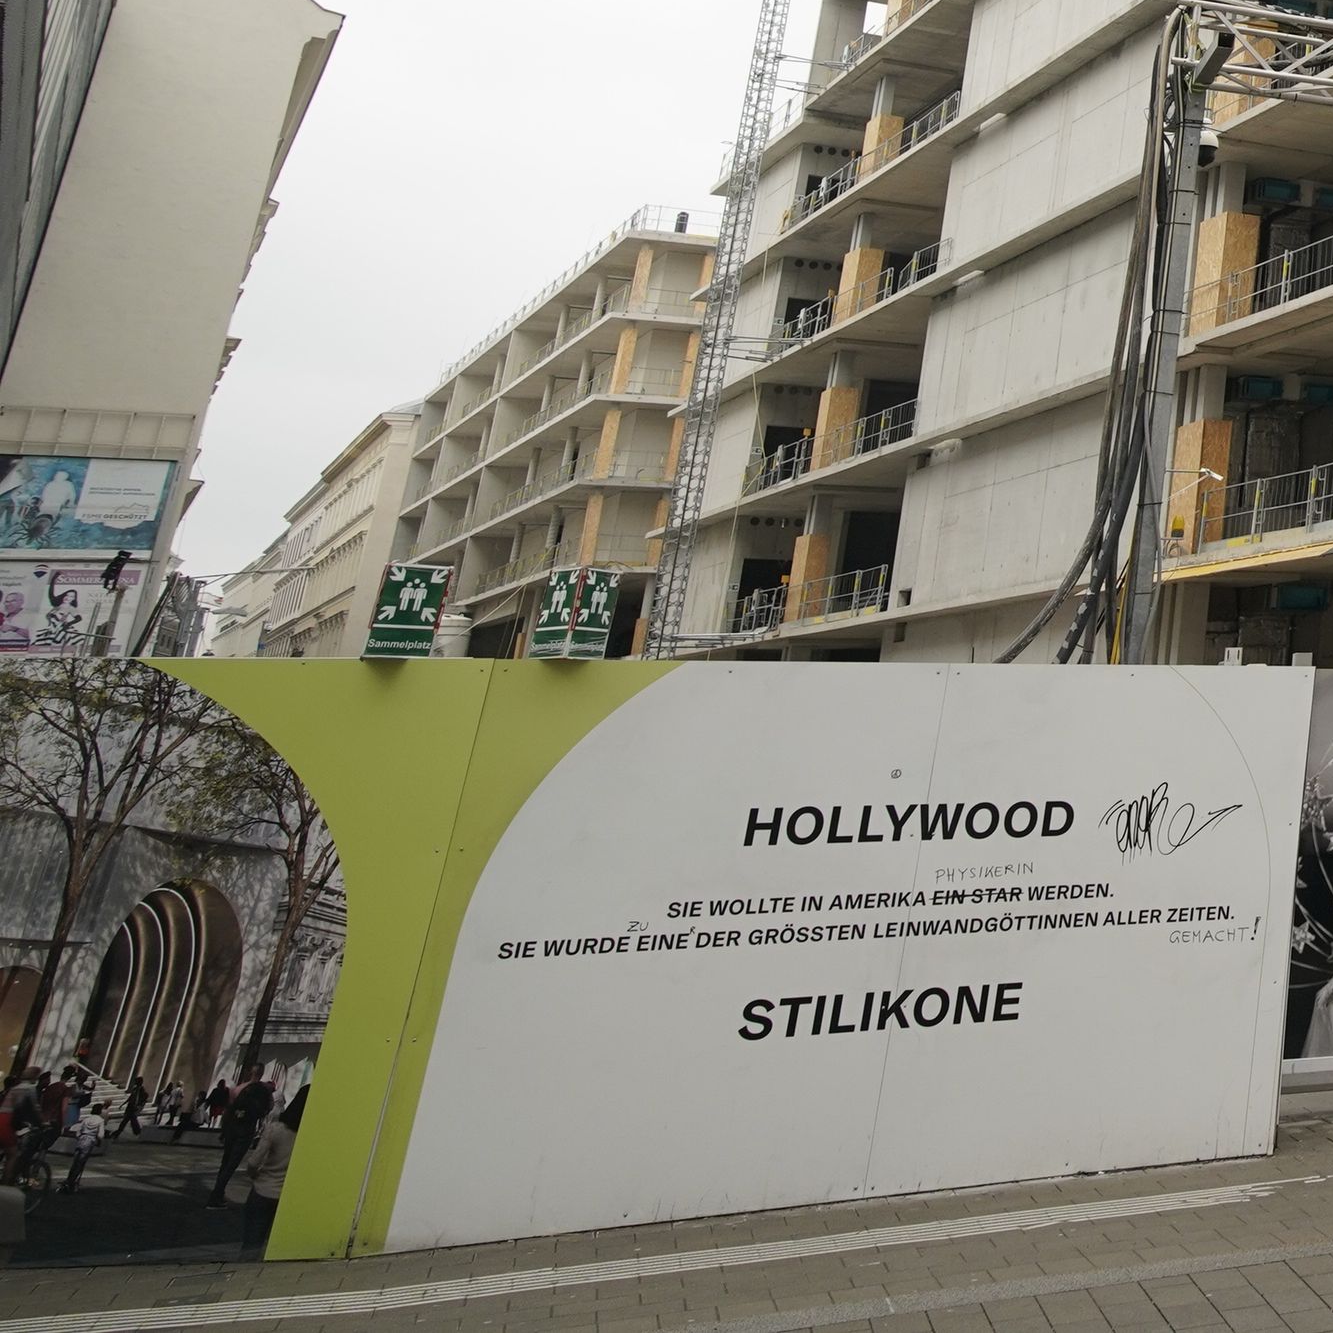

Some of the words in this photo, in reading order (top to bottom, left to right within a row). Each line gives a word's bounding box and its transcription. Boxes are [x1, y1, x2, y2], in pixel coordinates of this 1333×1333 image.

[367, 638, 432, 651] Sammelplatz
[743, 800, 1075, 847] HOLLYWOOD
[935, 861, 1034, 884] PHYSIKERIN
[666, 901, 703, 918] SIE
[709, 897, 795, 916] WOLLTE
[801, 896, 823, 912] IN
[828, 890, 926, 912] AMERIKA
[932, 890, 966, 906] EIN
[971, 887, 1023, 905] STAR
[1028, 882, 1115, 902] WERDEN.
[497, 941, 537, 959] SIE
[543, 936, 630, 957] WURDE
[636, 933, 689, 953] EINE
[695, 930, 741, 949] DER
[748, 923, 866, 946] GRÖSSTEN
[873, 912, 1099, 938] LEINWANDGÖTTINNEN
[1102, 908, 1162, 927] ALLER
[1166, 905, 1235, 923] ZEITEN.
[627, 921, 649, 933] ZU
[738, 982, 1023, 1041] STILIKONE
